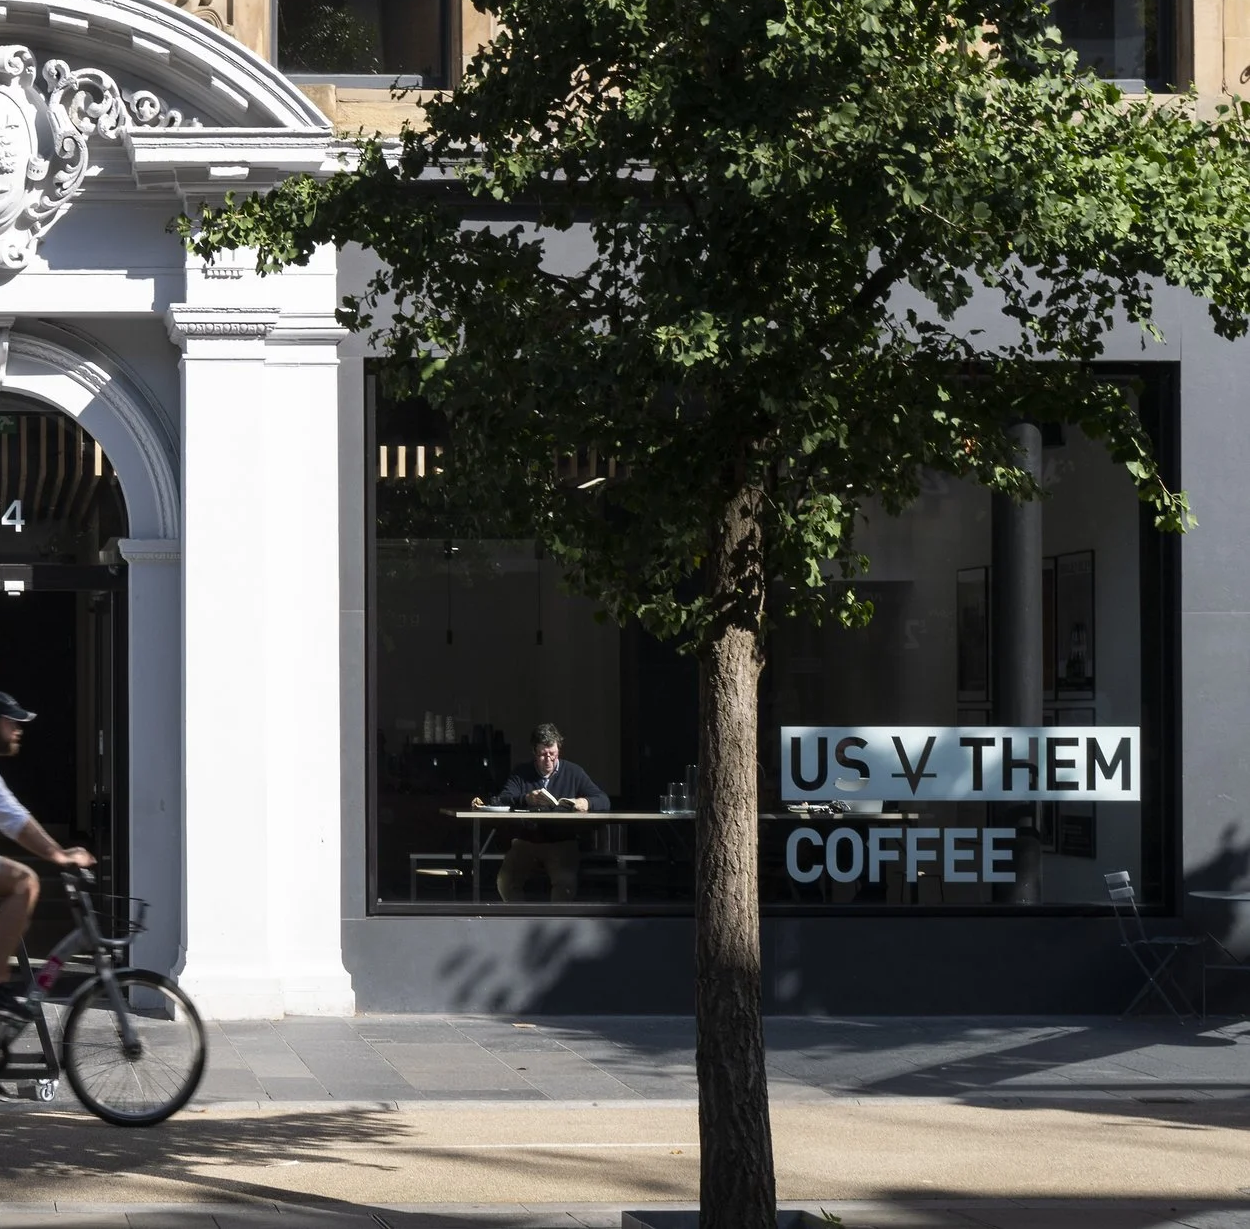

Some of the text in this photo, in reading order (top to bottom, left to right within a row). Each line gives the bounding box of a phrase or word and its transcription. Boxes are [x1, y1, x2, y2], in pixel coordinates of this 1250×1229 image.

[790, 736, 870, 792] US
[959, 737, 1131, 791] THEM
[786, 827, 1016, 883] COFFEE
